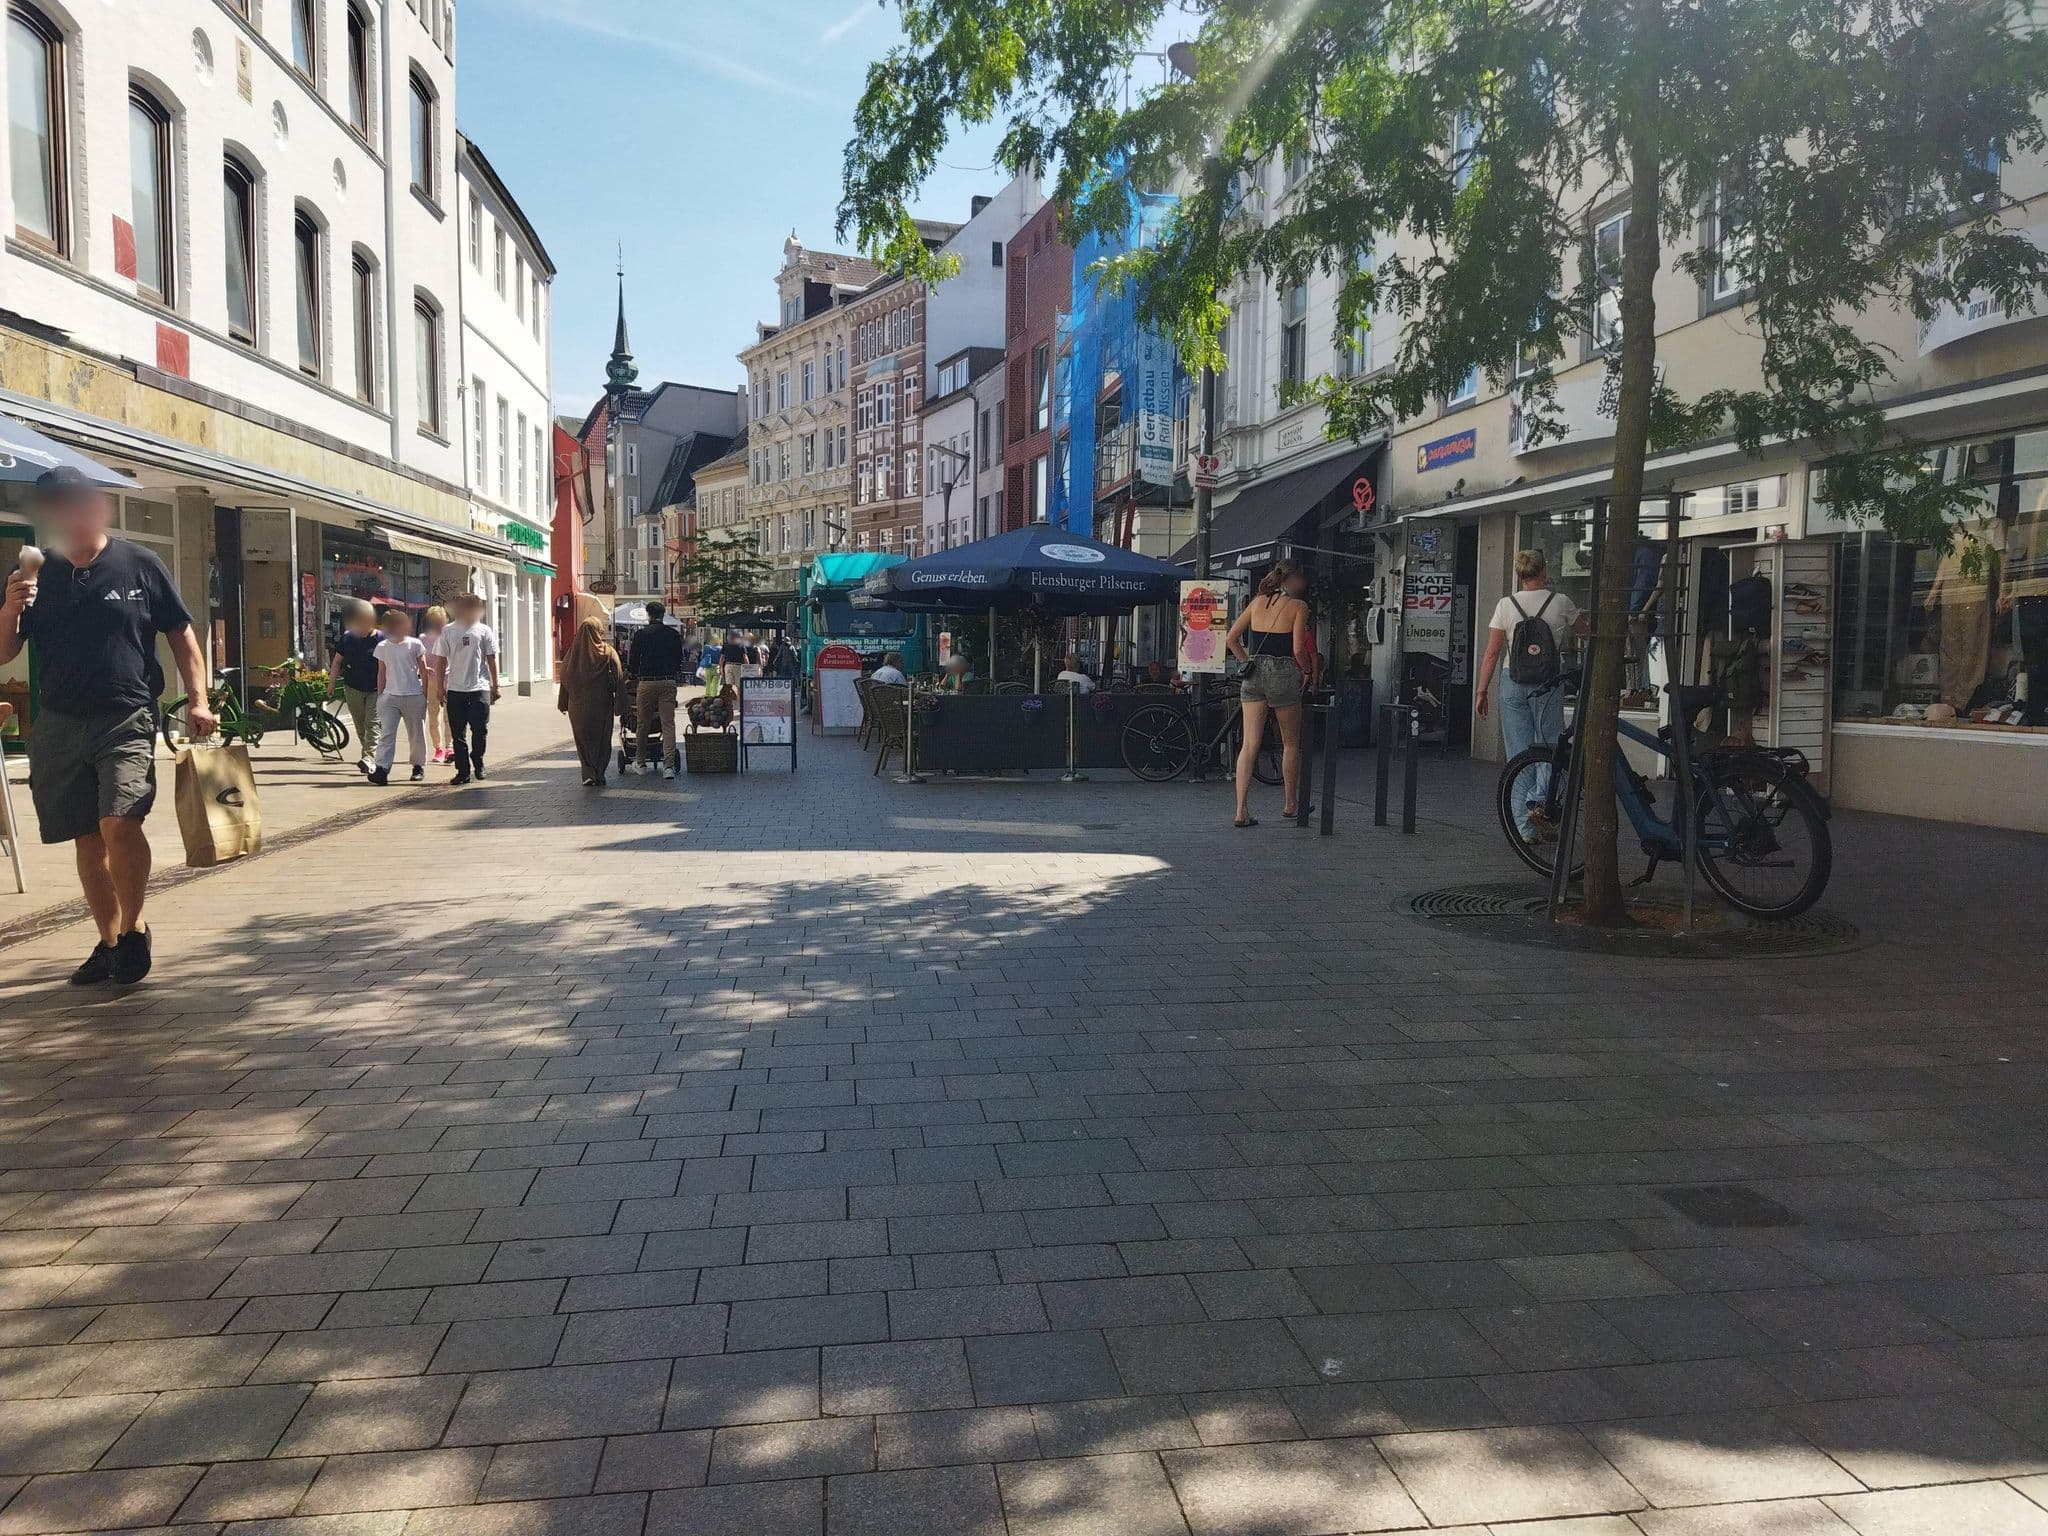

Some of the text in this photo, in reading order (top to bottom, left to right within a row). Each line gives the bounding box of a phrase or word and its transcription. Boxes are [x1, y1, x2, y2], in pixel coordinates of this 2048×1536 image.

[1968, 300, 1988, 321] OPEN
[1143, 370, 1155, 441] Gerüstbau
[1158, 371, 1170, 443] Ralf Nissen
[911, 569, 988, 584] Genuss erleben.
[1031, 571, 1146, 592] Flensburger Pilsener.
[1405, 575, 1451, 585] SKATE
[1405, 585, 1451, 595] SHOP
[1404, 595, 1451, 610] 247
[881, 638, 906, 646] Nissen
